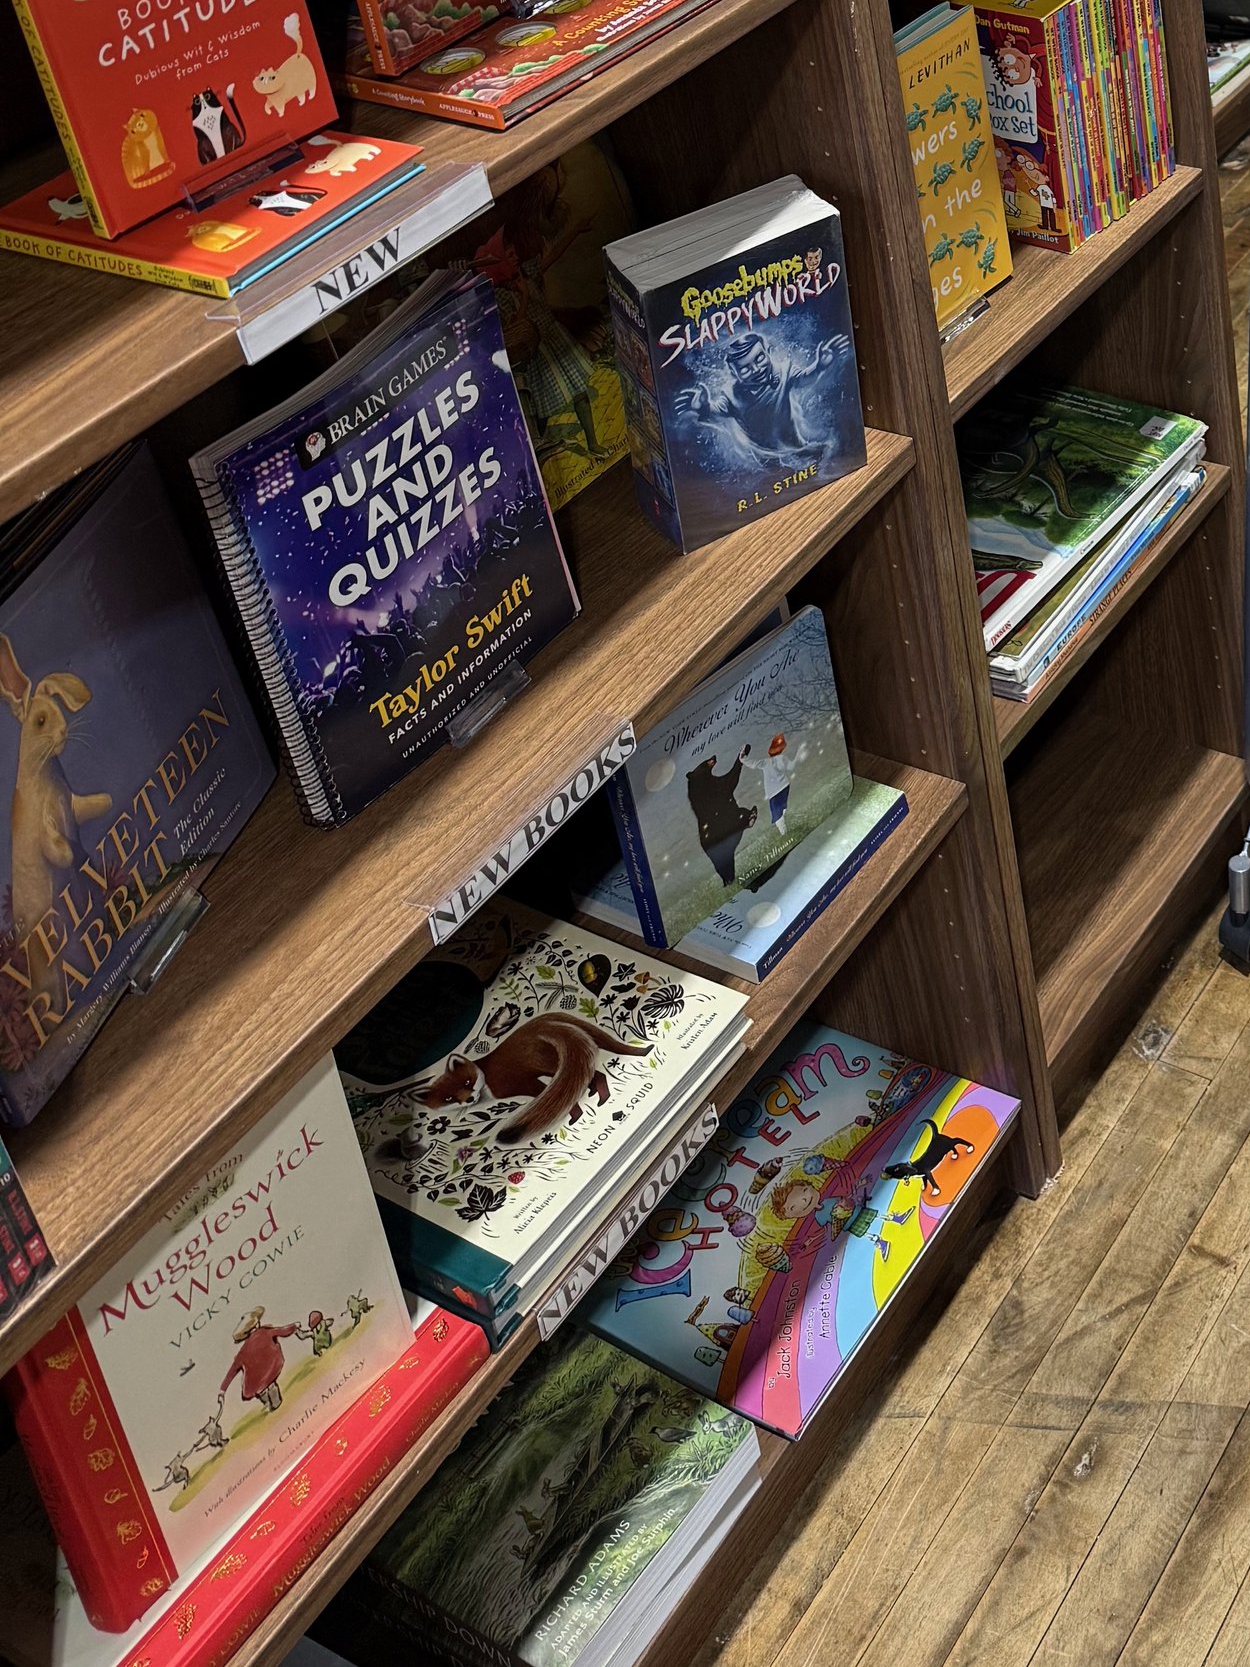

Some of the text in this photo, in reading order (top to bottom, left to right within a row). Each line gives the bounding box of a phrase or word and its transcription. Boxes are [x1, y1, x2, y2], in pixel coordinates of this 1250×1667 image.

[909, 38, 971, 89] LEVITHAN
[311, 230, 403, 313] NEW
[681, 254, 803, 317] Goosebumps
[301, 370, 480, 532] PUZZLES
[328, 446, 502, 606] QUIZZES
[366, 444, 454, 539] AND
[369, 573, 534, 729] Taylor Swift
[3, 689, 230, 992] VELVETEEN
[433, 723, 637, 932] NEW BOOKS
[25, 833, 177, 1046] RABBIT
[99, 1124, 323, 1336] Muggleswick
[172, 1205, 280, 1314] Wood
[538, 1114, 717, 1340] NEW BOOKS
[535, 1520, 630, 1640] RICHARD ADAMS
